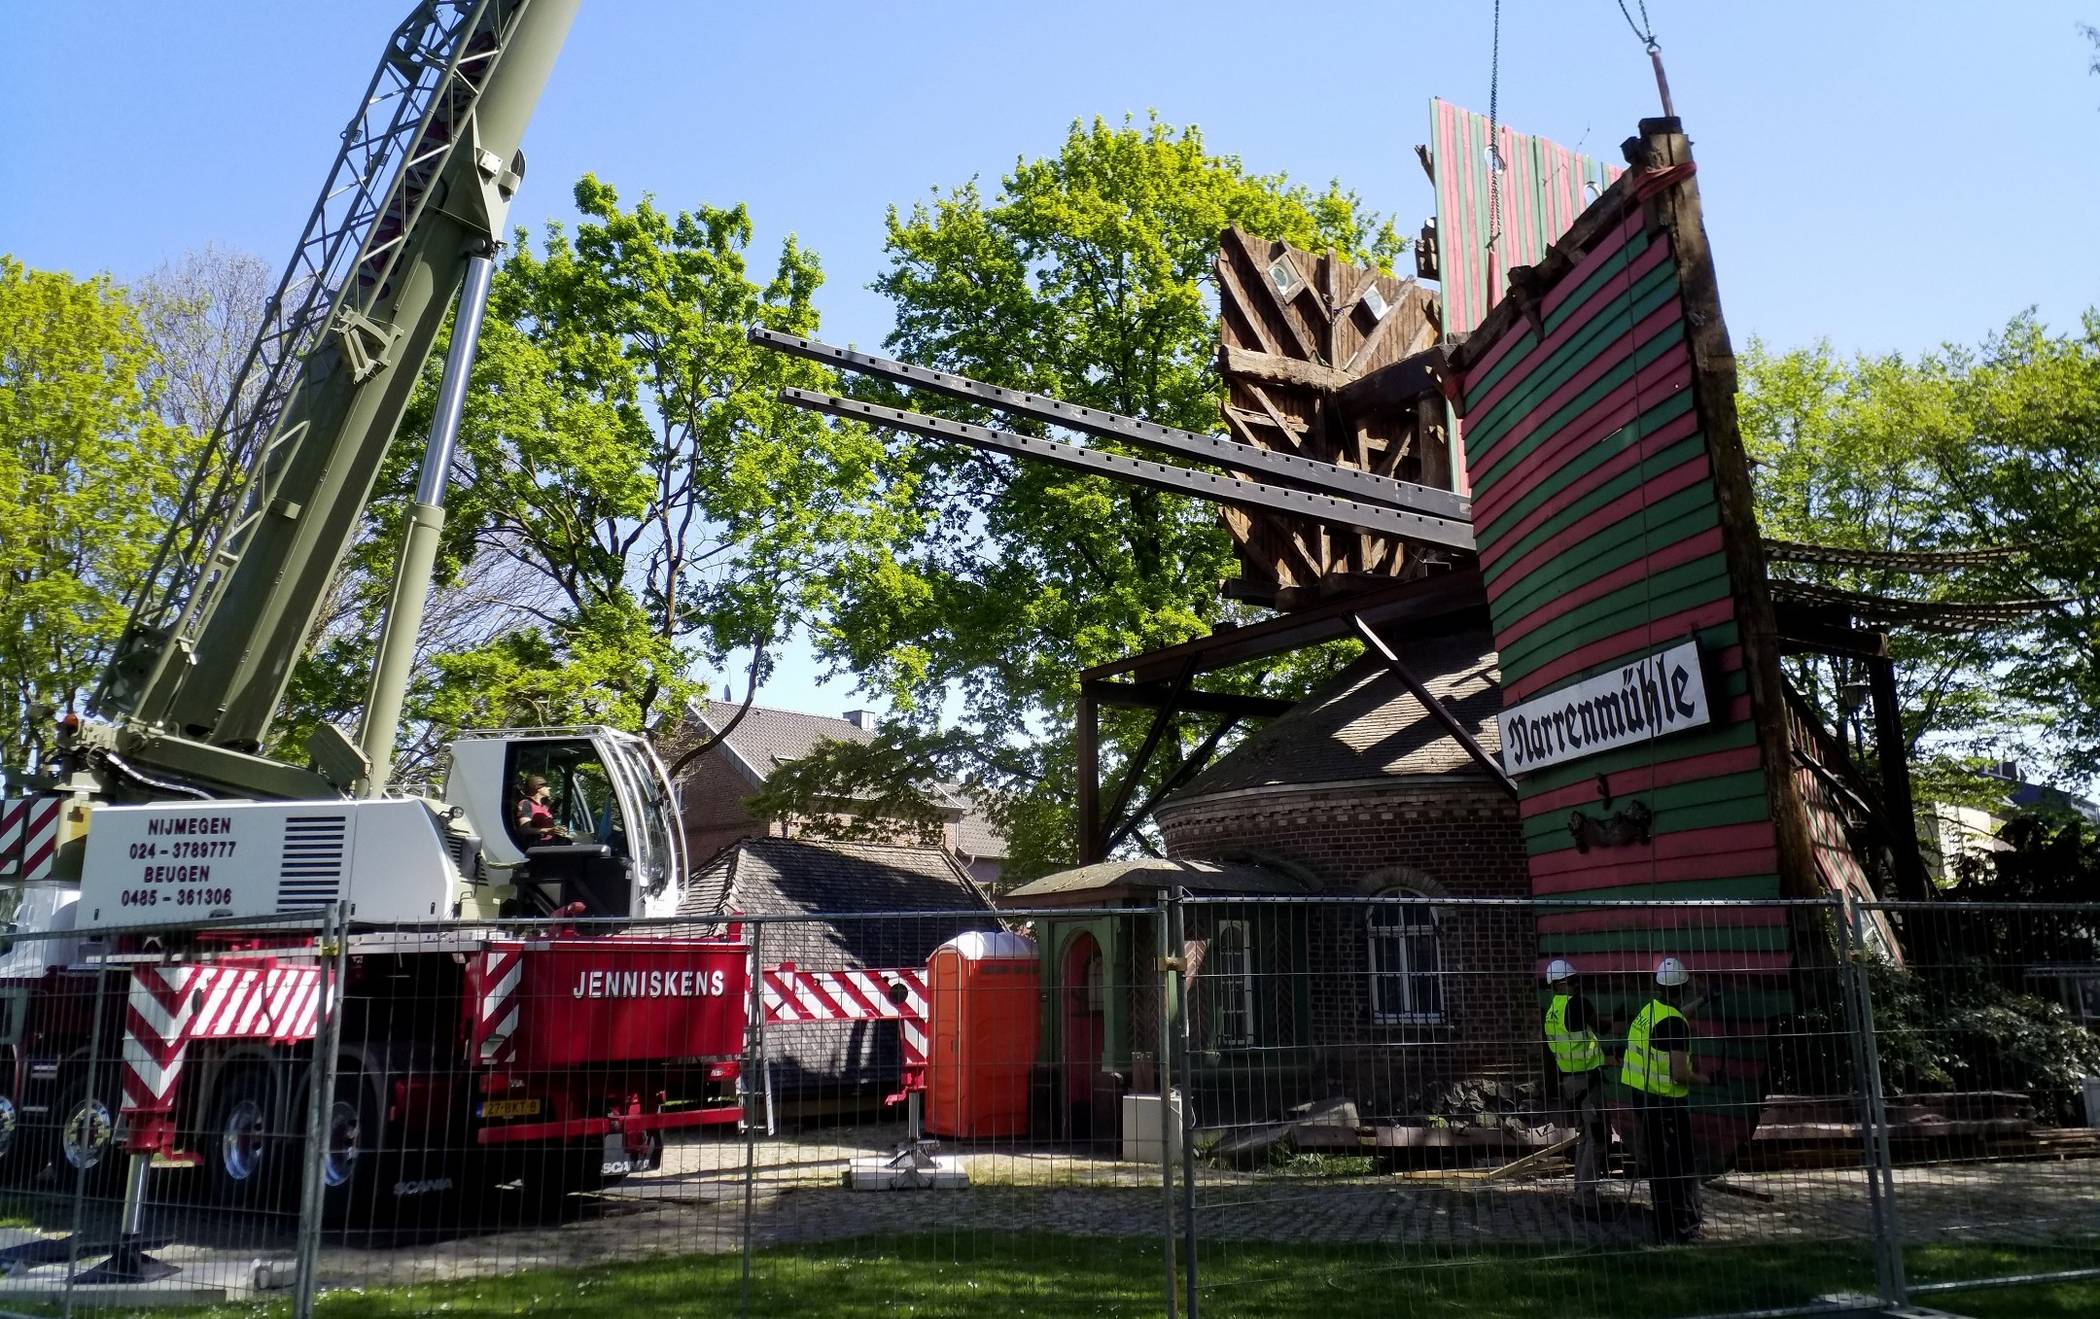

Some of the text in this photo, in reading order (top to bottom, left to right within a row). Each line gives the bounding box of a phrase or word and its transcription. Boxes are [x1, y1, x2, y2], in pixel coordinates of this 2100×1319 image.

[1508, 653, 1695, 766] Narrenmühle
[148, 817, 231, 835] NIJMEGEN
[129, 842, 156, 859] 024
[172, 841, 236, 858] 3789777
[144, 865, 210, 883] BEUGEN
[121, 889, 157, 906] 0485
[177, 888, 232, 905] 361306
[573, 970, 725, 998] JENNISKENS
[600, 1158, 650, 1175] SCAIA
